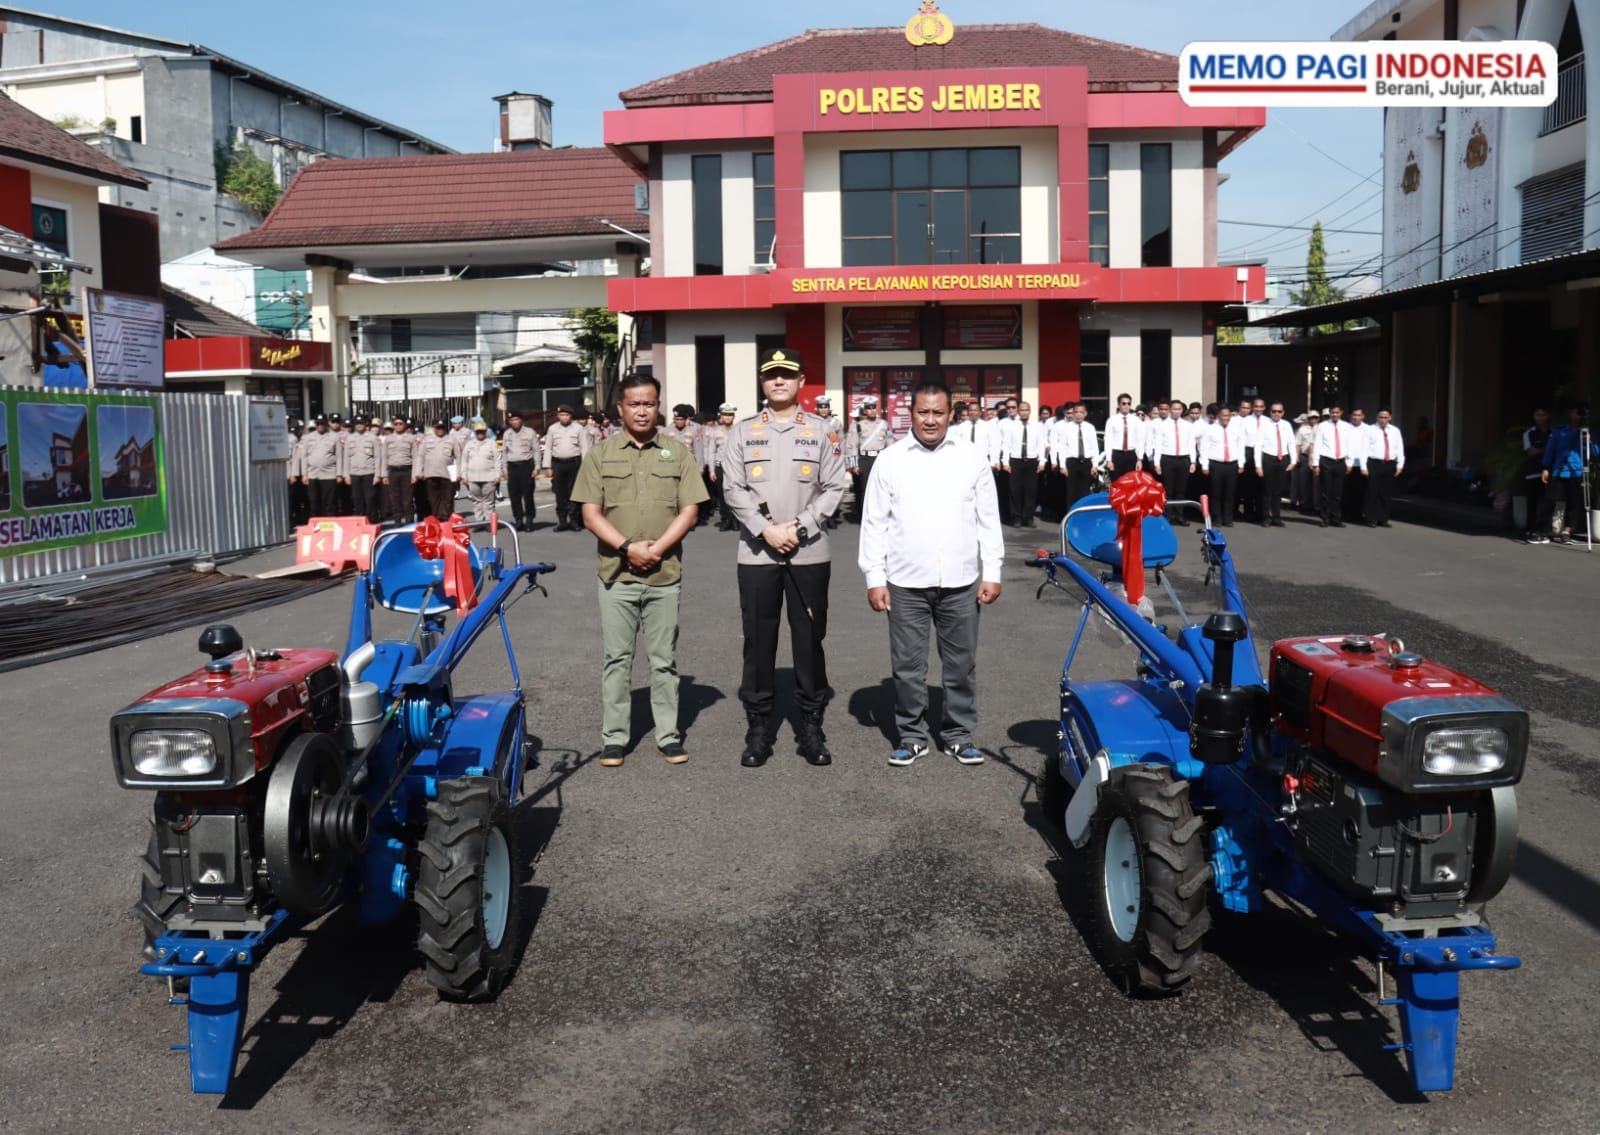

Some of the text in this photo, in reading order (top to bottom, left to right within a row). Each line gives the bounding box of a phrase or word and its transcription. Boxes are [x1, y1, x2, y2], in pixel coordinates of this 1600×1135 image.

[819, 83, 1042, 115] POLRES JEMBER
[791, 273, 1080, 292] SENTRA PELAYANAN KEPOLISIAN TERPADU
[0, 506, 136, 545] SELAMATAN KERJA
